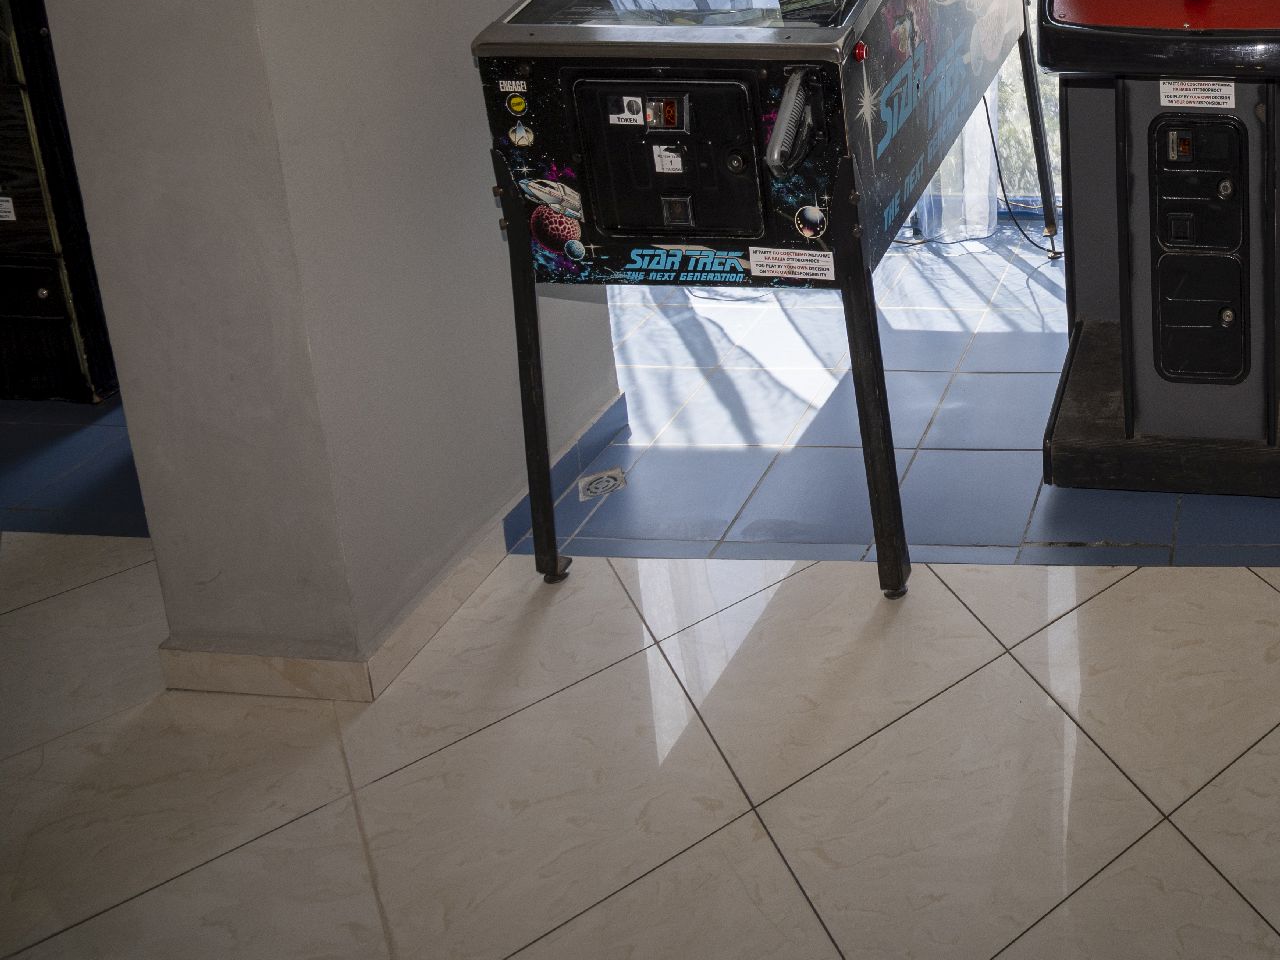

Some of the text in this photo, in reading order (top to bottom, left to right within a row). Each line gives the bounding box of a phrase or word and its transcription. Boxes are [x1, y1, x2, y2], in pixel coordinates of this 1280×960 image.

[499, 80, 527, 92] ENGAGE!
[877, 41, 926, 161] STAR
[883, 188, 901, 232] THE
[904, 153, 925, 203] NEXT
[623, 248, 745, 271] STAR TREK
[625, 271, 743, 282] THE NEXT GENERATION
